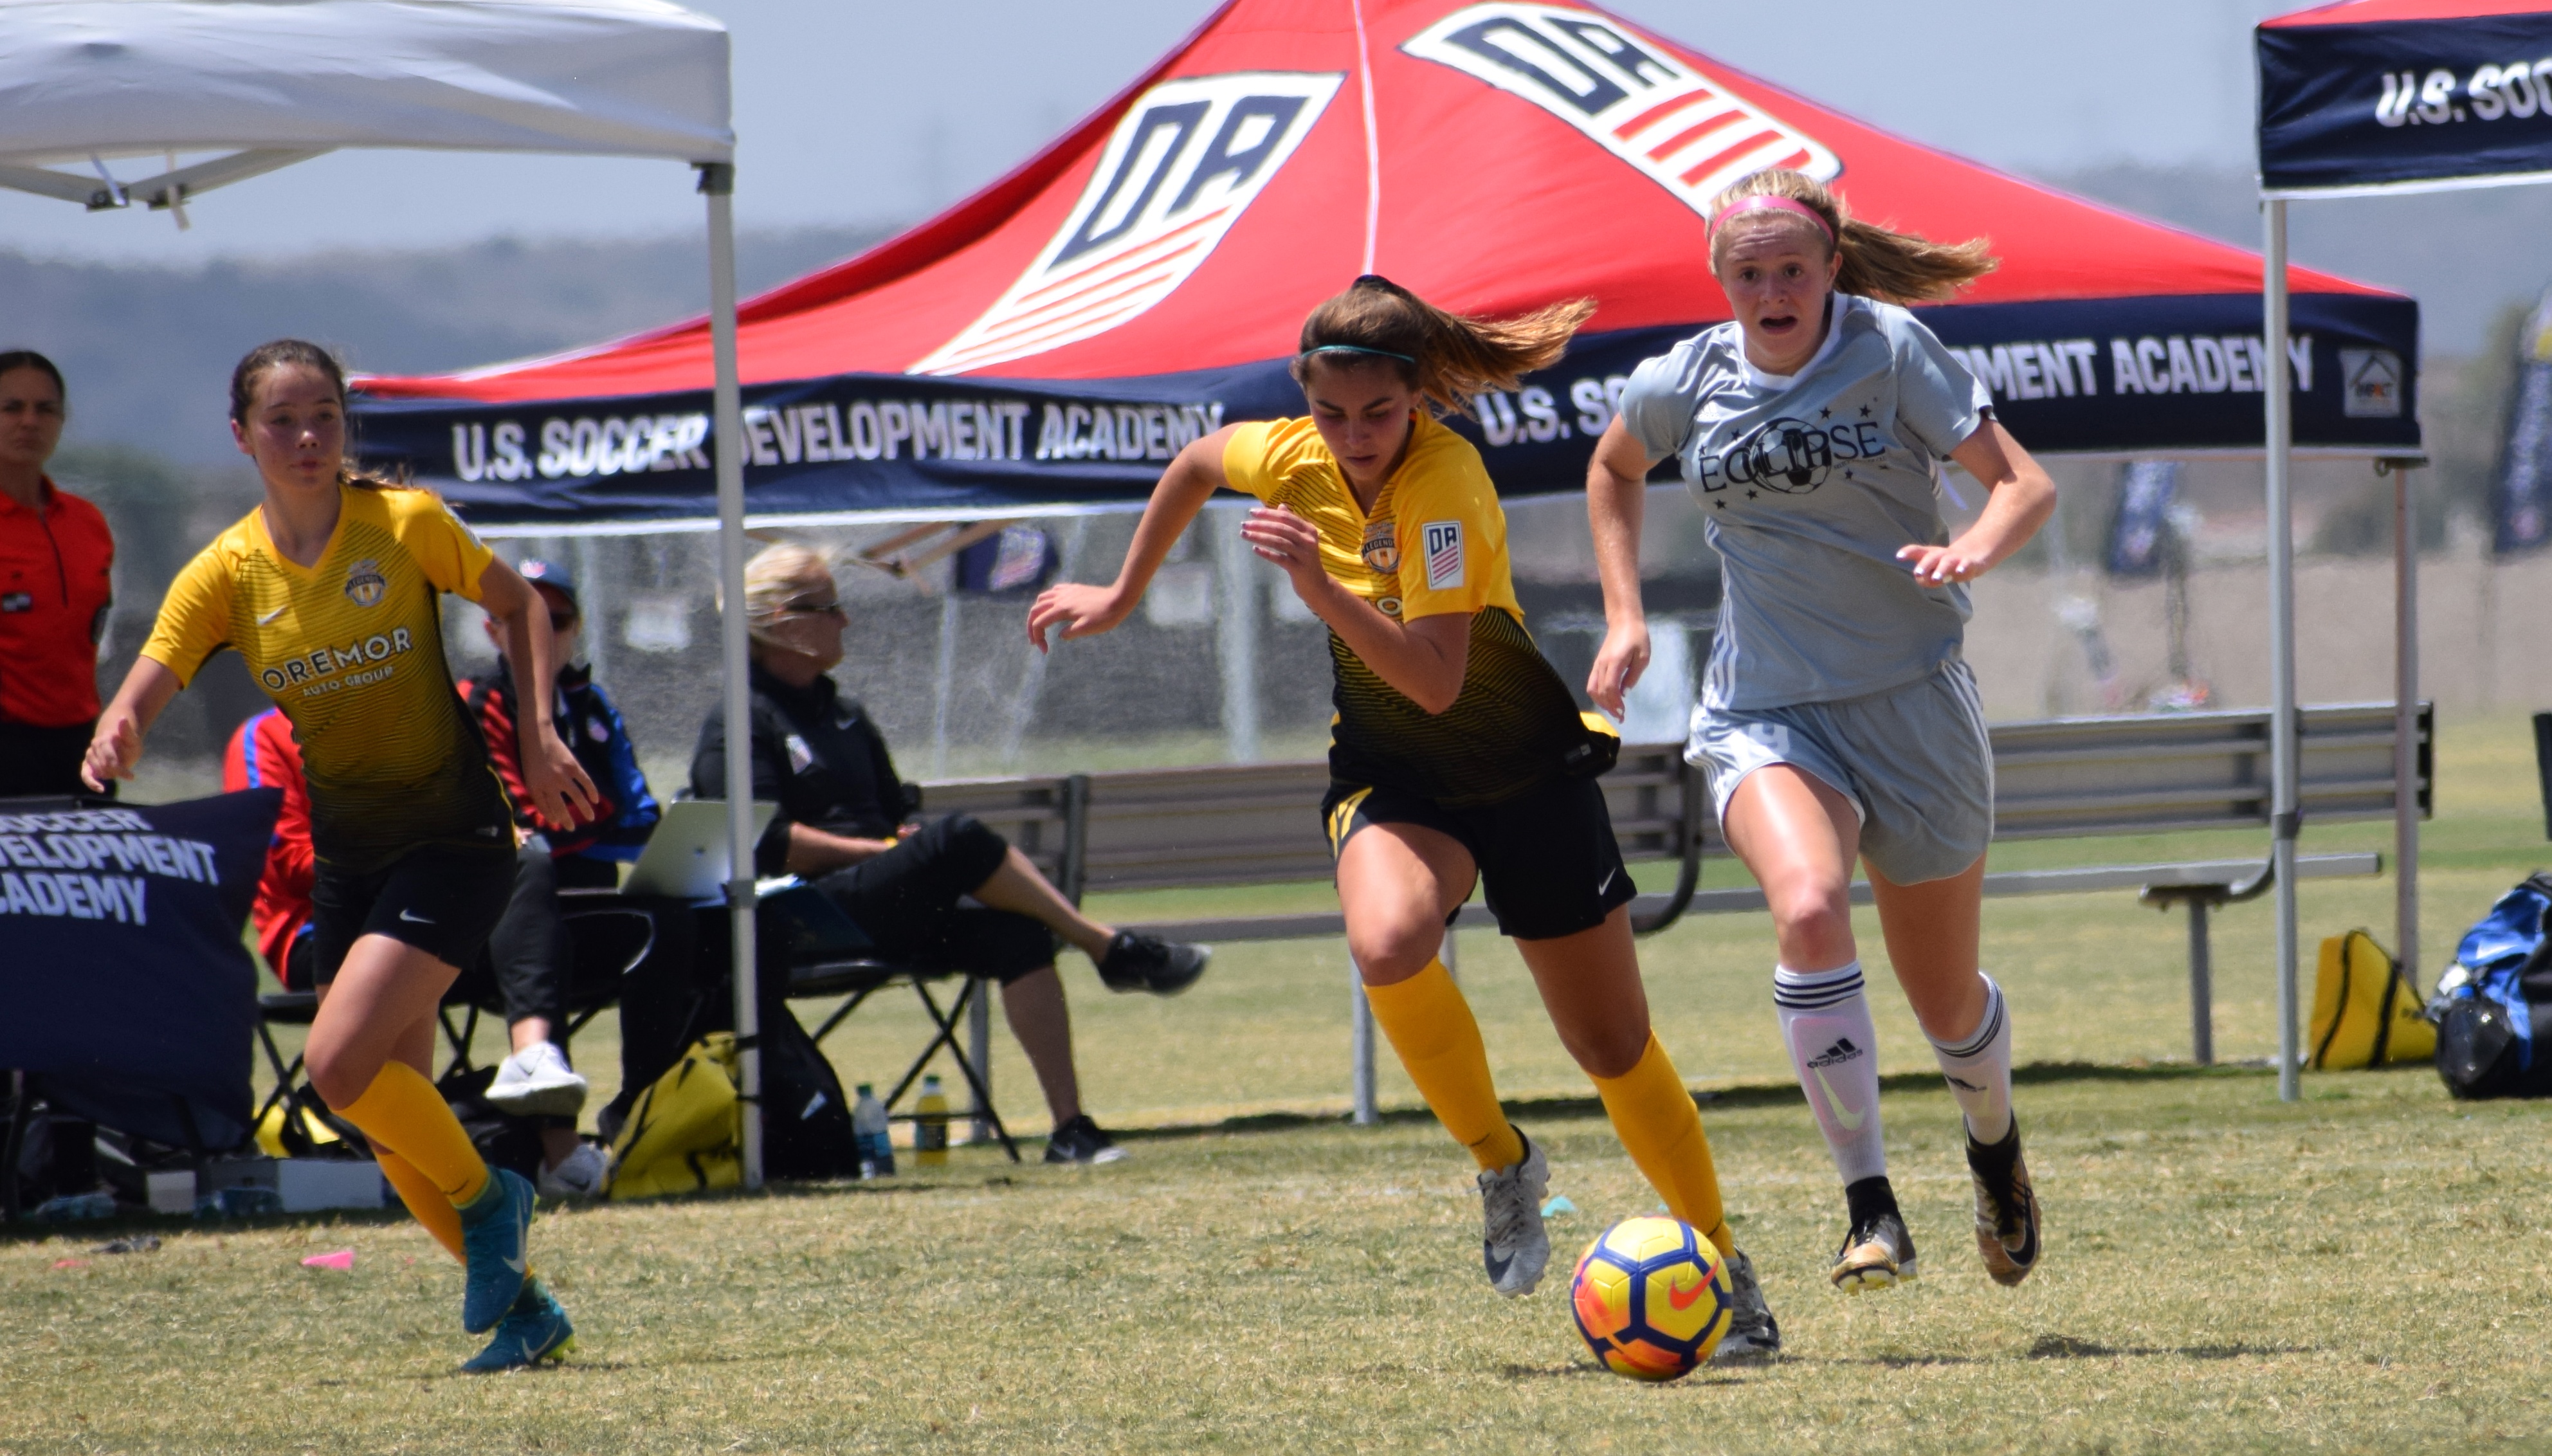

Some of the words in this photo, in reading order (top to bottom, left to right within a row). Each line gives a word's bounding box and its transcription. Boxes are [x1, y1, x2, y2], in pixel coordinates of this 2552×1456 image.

[1441, 16, 1681, 118] DA
[2375, 69, 2467, 127] U.S.
[1043, 95, 1313, 276] DA
[452, 421, 533, 482] U.S.
[537, 414, 711, 478] SOCCER
[741, 399, 1030, 466] EVELOPMENT
[1035, 401, 1224, 461] ACADEMY
[1474, 386, 1572, 447] U.S.
[1699, 421, 1885, 493] ECLIPSE
[1428, 527, 1457, 556] DA
[261, 626, 413, 692] OREMOR
[303, 680, 340, 696] AUTO
[345, 666, 393, 686] GROUP
[0, 808, 154, 833] OCCER
[0, 833, 219, 887] ELOPMENT
[0, 869, 147, 926] ADEMY
[1807, 1049, 1863, 1068] adidas
